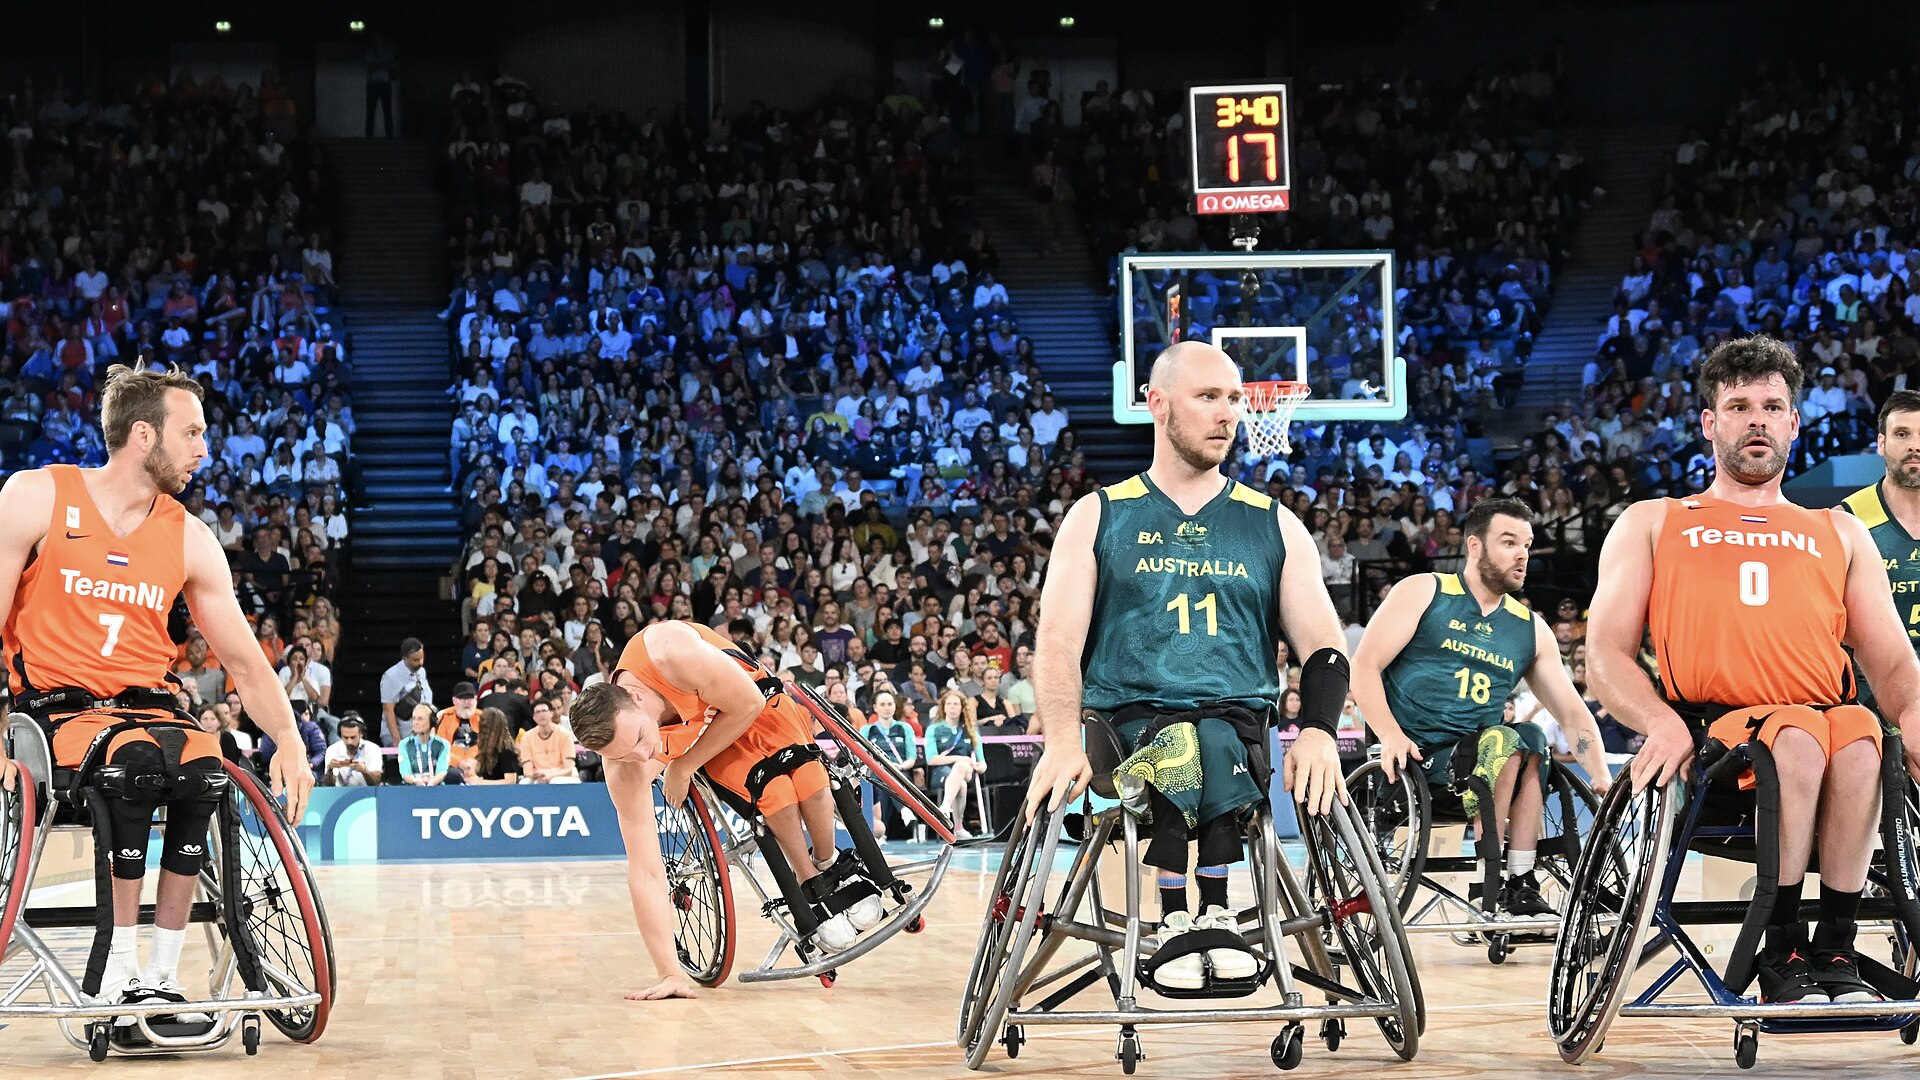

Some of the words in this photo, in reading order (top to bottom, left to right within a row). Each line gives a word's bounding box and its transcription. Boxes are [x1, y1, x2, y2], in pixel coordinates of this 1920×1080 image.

[1216, 96, 1279, 128] 3:40
[1227, 133, 1277, 182] 17
[1222, 194, 1285, 209] OMEGA
[1137, 531, 1164, 545] BA
[1681, 525, 1822, 559] TeamNL
[1135, 557, 1249, 579] AUSTRALIA
[1738, 561, 1769, 606] 0
[60, 568, 165, 612] TeamNL
[1166, 592, 1218, 636] 11
[98, 613, 125, 657] 7
[1441, 638, 1514, 672] AUSTRALIA
[1454, 667, 1491, 705] 18
[412, 805, 590, 840] TOYOTA
